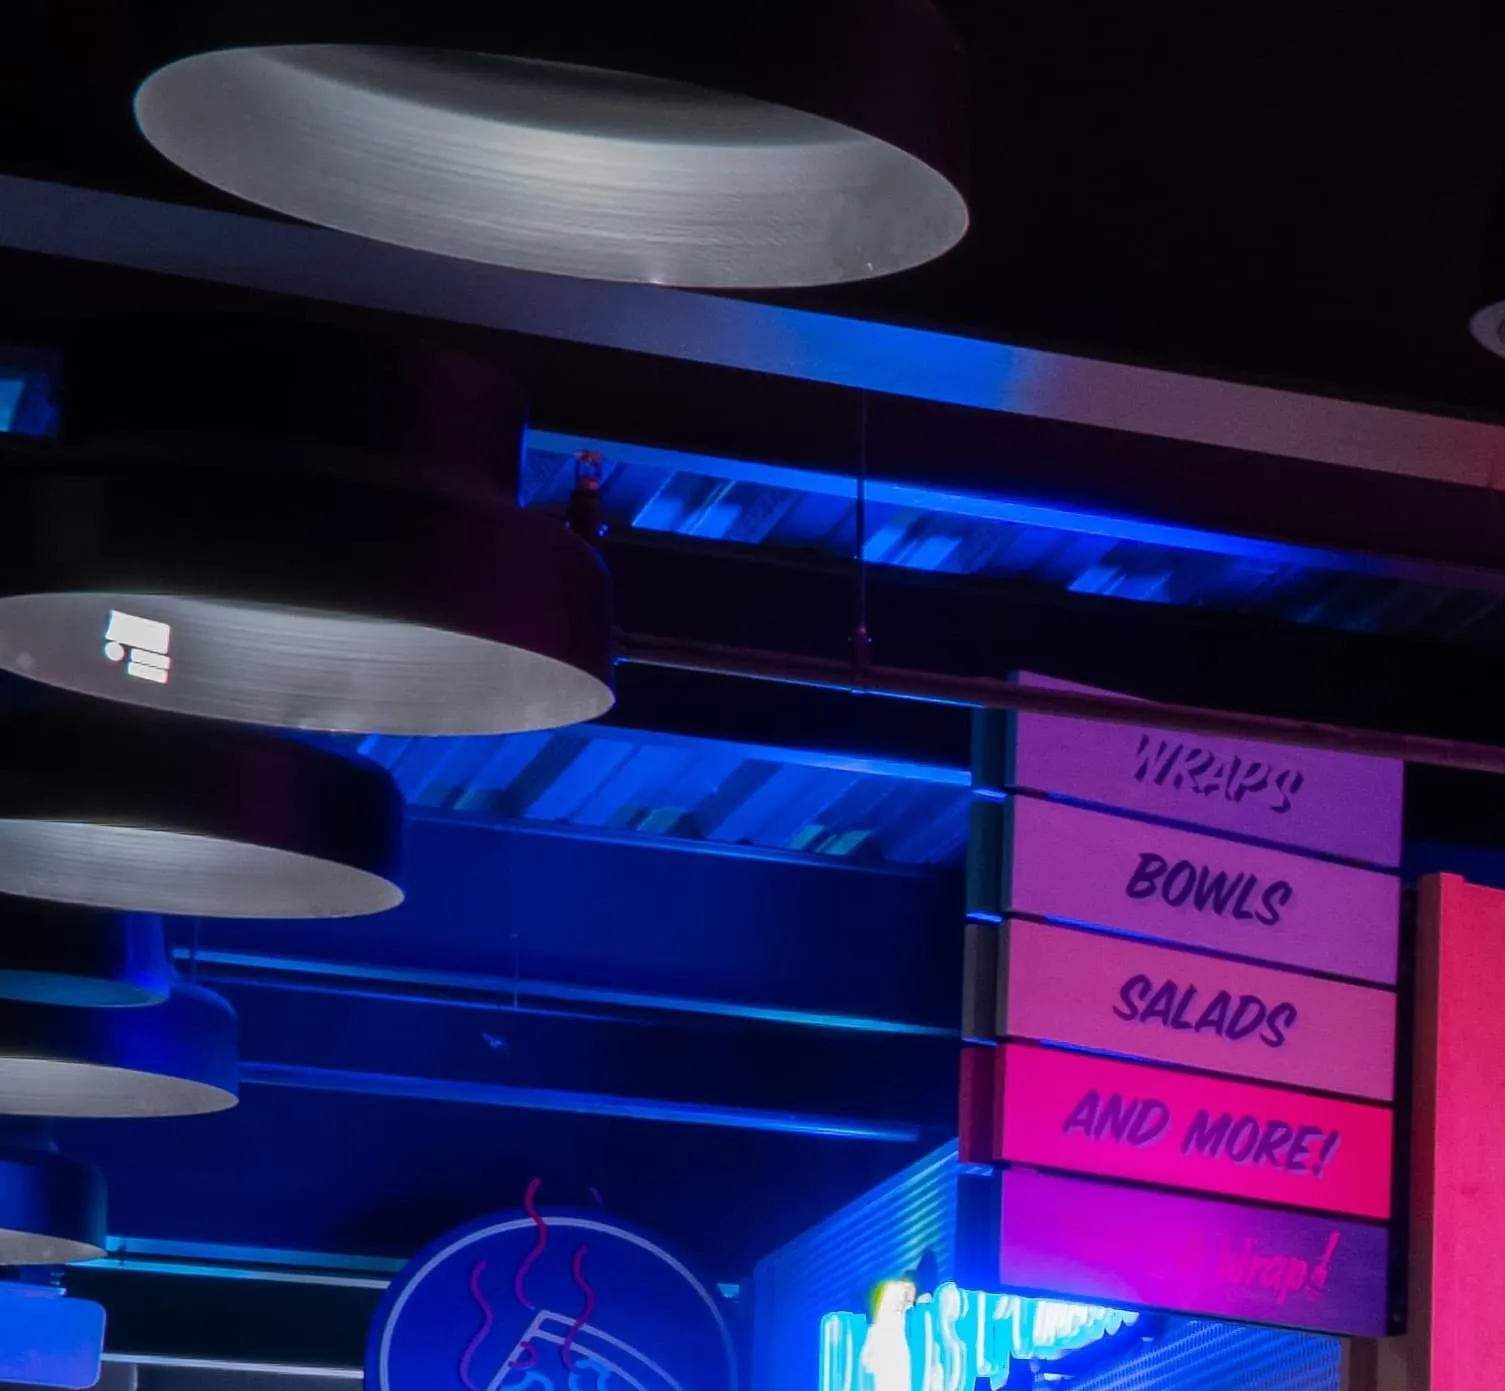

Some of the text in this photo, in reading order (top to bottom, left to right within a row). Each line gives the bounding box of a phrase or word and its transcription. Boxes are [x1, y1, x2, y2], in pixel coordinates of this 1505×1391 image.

[1133, 734, 1306, 815] WRAPS
[1125, 852, 1293, 927] BOWLS
[1112, 974, 1299, 1049] SALADS
[1063, 1088, 1340, 1179] AND MORE!
